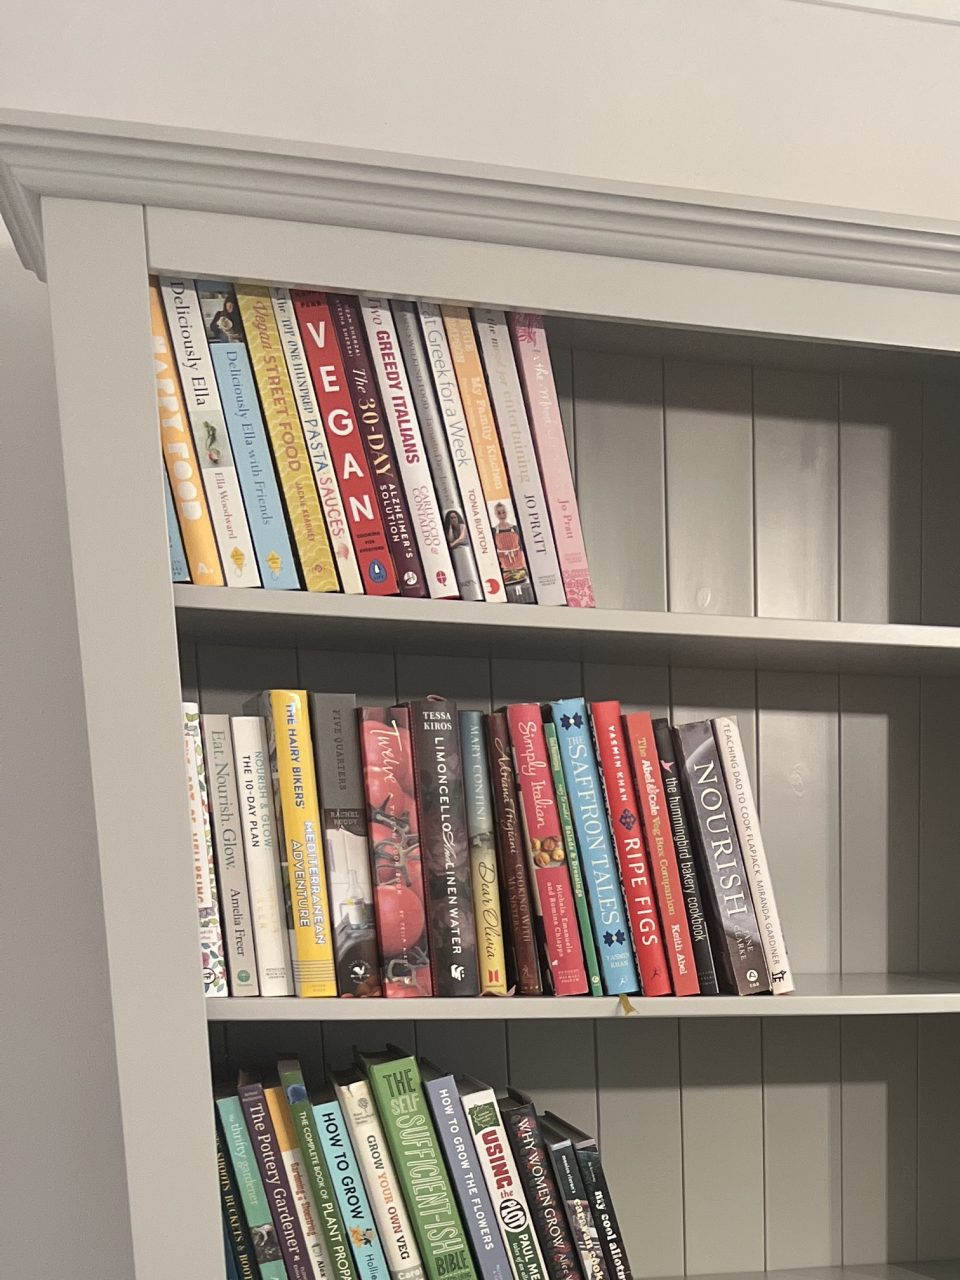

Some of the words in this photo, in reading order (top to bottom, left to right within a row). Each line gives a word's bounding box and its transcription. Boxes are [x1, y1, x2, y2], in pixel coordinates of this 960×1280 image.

[170, 281, 202, 371] Deliciously
[191, 377, 210, 406] Ella
[226, 351, 247, 418] Deliciously
[252, 300, 270, 353] Vegan
[264, 355, 289, 417] STREET
[279, 422, 301, 472] FOOD
[352, 368, 368, 394] The
[375, 330, 403, 391] GREEDY
[391, 396, 420, 465] ITALIANS
[241, 423, 253, 446] Ella
[306, 321, 375, 523] VEGAN
[358, 398, 394, 479] 30-DAY
[248, 450, 263, 477] with
[214, 472, 225, 490] Ella
[220, 490, 237, 539] Woodward
[254, 481, 273, 526] Friends
[468, 488, 479, 518] TONIA
[474, 519, 488, 554] BUXTON
[285, 704, 296, 725] THE
[422, 711, 452, 720] TESSA
[423, 721, 452, 730] KIROS
[242, 755, 252, 774] THE
[287, 728, 300, 762] HAIRY
[518, 721, 547, 776] Simply
[567, 735, 585, 746] THE
[245, 779, 257, 818] 10-DAY
[434, 737, 452, 832] LIMONCELLO
[531, 779, 553, 829] Italian
[567, 744, 605, 850] SAFFRON
[665, 777, 677, 793] the
[249, 821, 260, 847] PLAN
[668, 796, 689, 860] hummingbird
[693, 760, 748, 917] NOURISH
[291, 840, 310, 927] ADVENTURE
[303, 821, 326, 945] MEDITERRANEAN
[624, 838, 648, 888] RIPE
[681, 861, 697, 898] bakery
[591, 857, 620, 926] TALES
[635, 896, 658, 947] FIGS
[686, 898, 705, 942] cookbook
[322, 1112, 344, 1148] HOW
[334, 1152, 349, 1171] TO
[342, 1175, 365, 1220] GROW
[366, 1135, 385, 1170] GROW
[481, 1129, 514, 1191] USING
[250, 1104, 265, 1130] The
[259, 1136, 280, 1184] Pottery
[272, 1188, 299, 1254] Gardener
[377, 1174, 394, 1205] YOUR
[518, 1117, 535, 1150] WHY
[529, 1153, 552, 1207] WOMEN
[543, 1208, 566, 1249] GROW
[386, 1206, 403, 1234] OWN
[394, 1235, 410, 1261] VEG
[518, 1233, 535, 1263] PAUL
